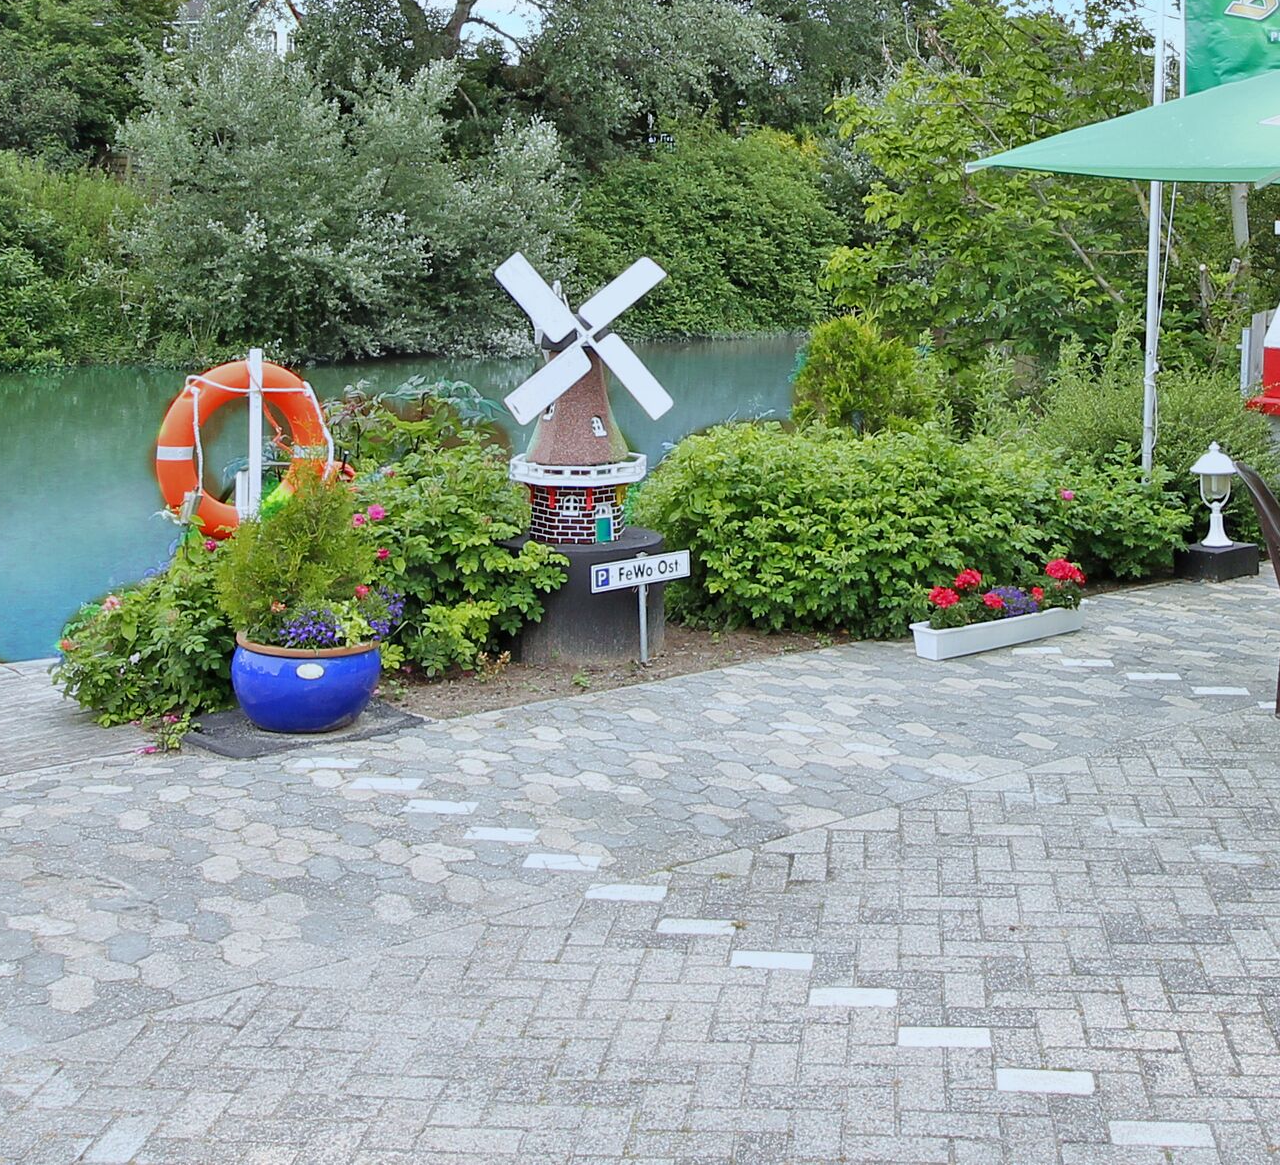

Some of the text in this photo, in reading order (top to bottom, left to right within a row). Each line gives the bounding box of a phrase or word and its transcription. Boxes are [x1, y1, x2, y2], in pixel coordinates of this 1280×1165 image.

[597, 560, 680, 586] P FeWo Ost
